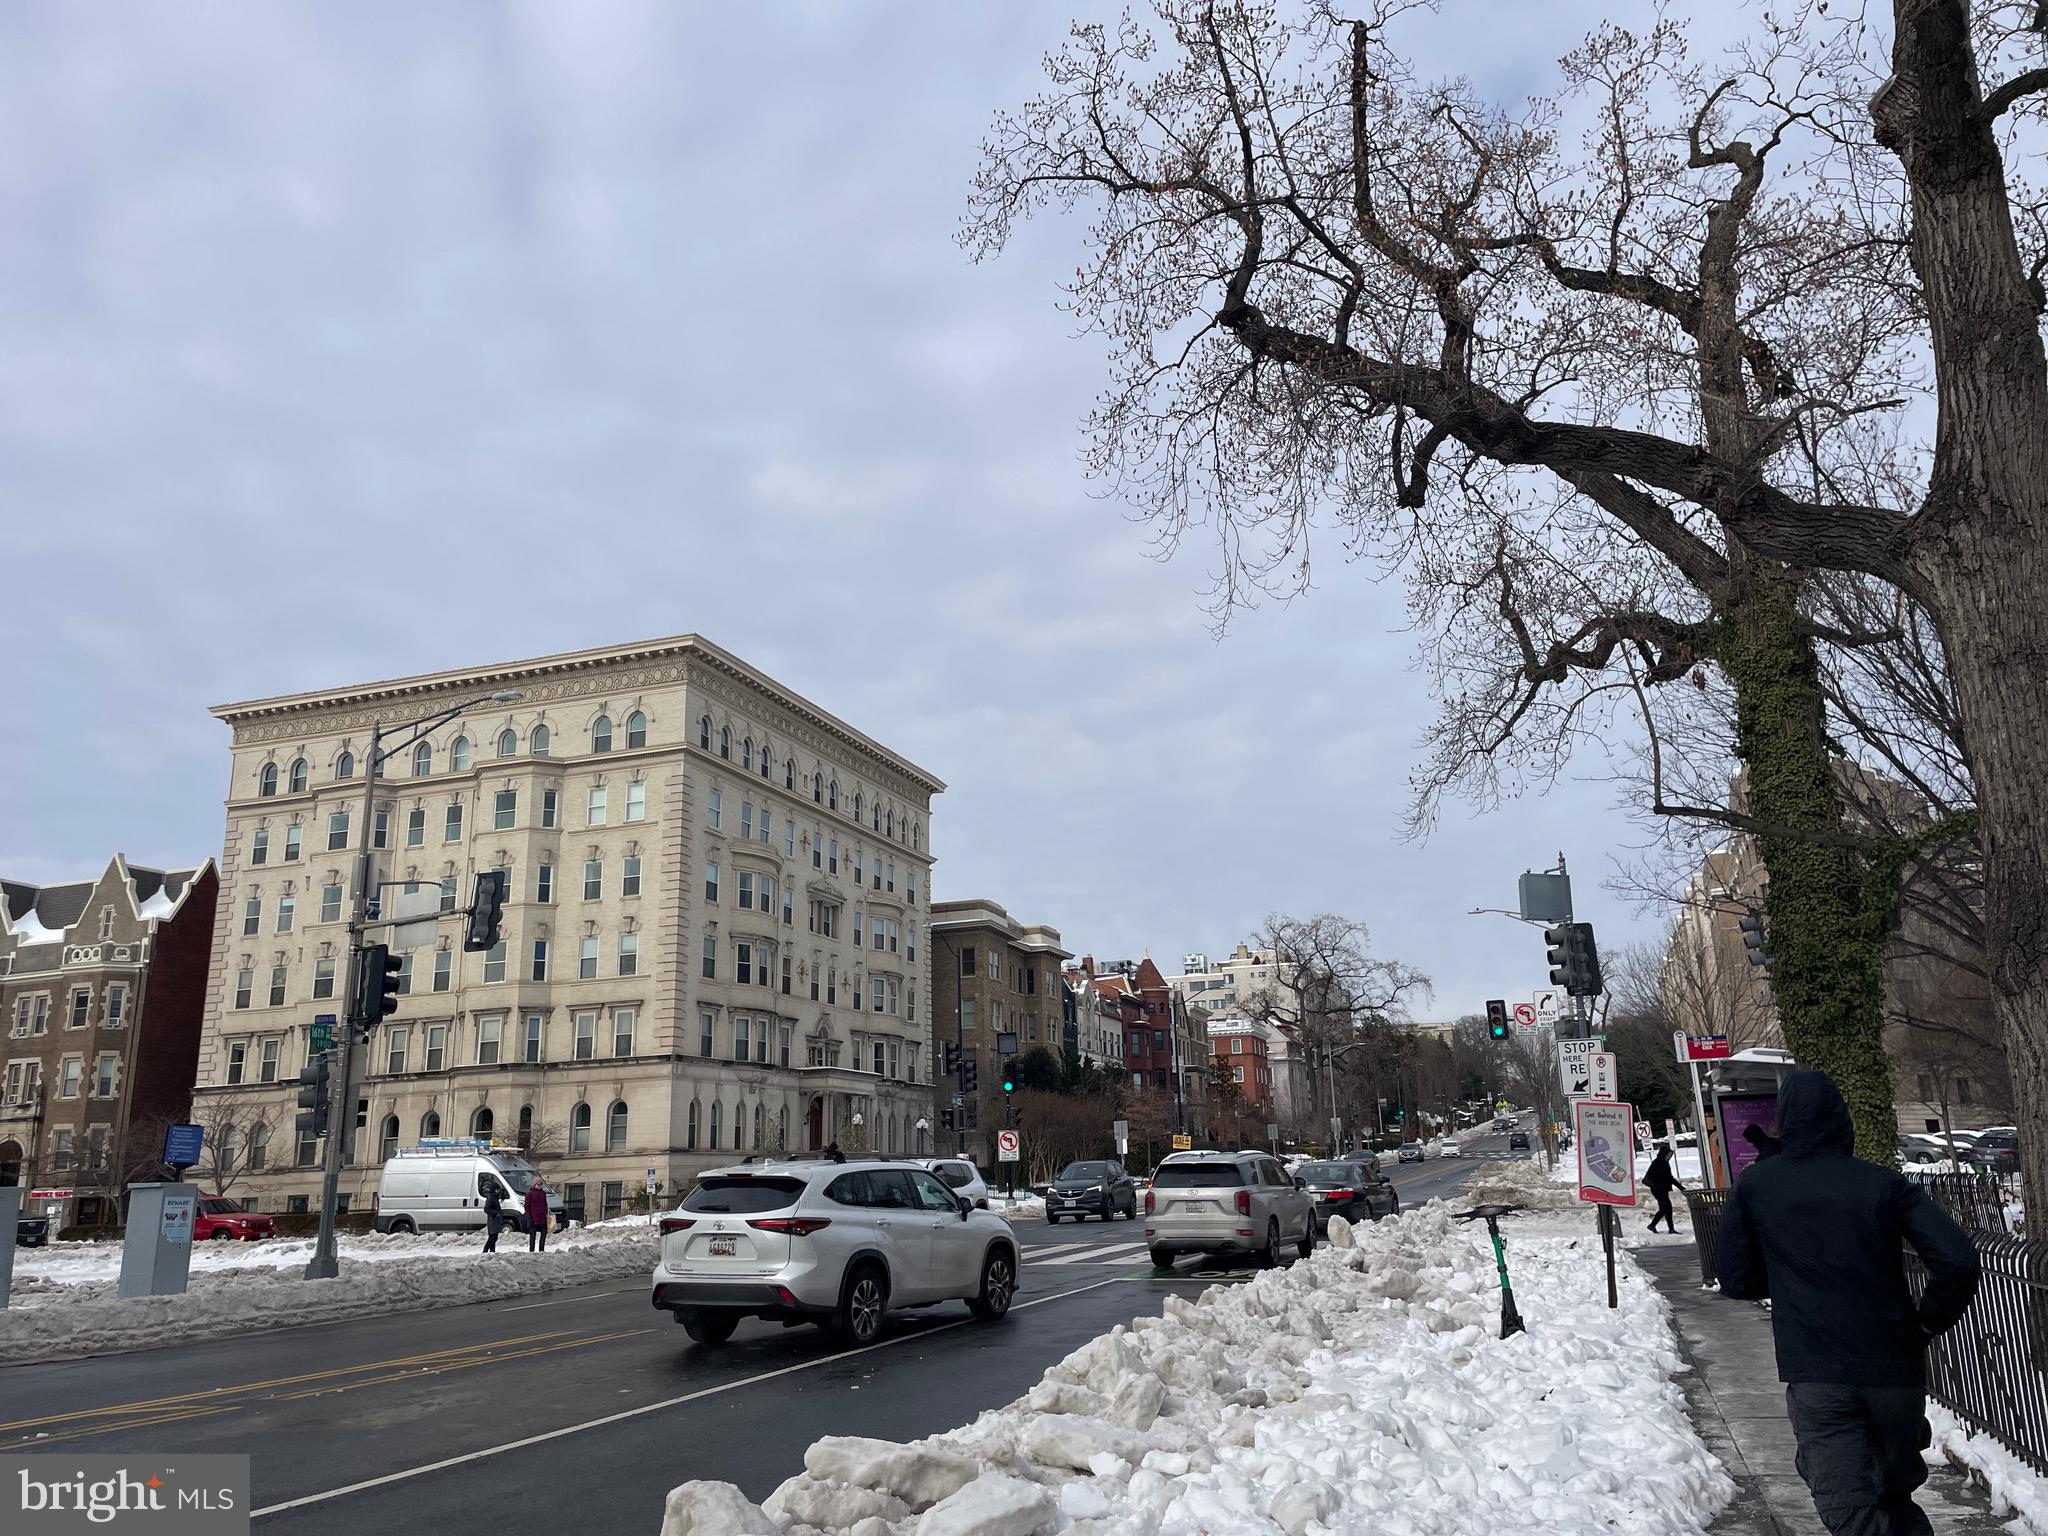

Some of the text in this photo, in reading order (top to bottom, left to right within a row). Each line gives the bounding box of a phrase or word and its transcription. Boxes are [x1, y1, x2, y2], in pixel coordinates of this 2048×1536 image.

[317, 1040, 332, 1048] 1900
[1564, 1042, 1595, 1054] STOP
[1563, 1055, 1583, 1063] HERE
[1570, 1063, 1587, 1074] RE
[1597, 1111, 1616, 1119] Behind
